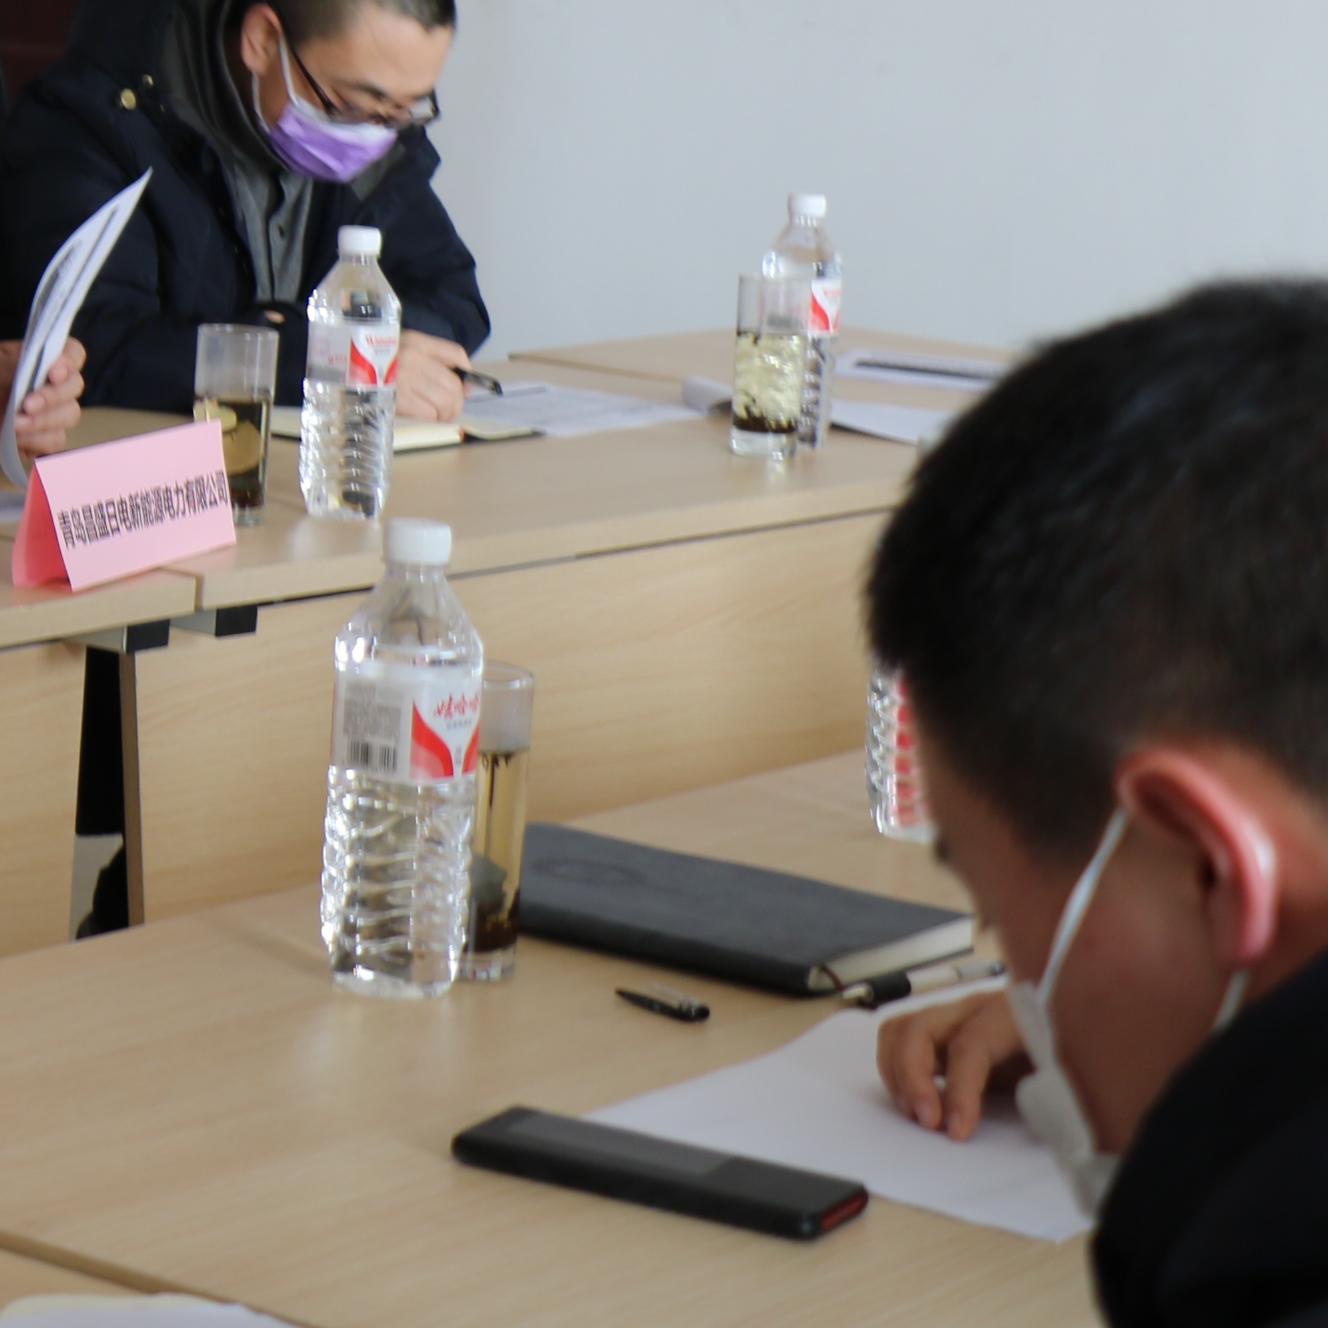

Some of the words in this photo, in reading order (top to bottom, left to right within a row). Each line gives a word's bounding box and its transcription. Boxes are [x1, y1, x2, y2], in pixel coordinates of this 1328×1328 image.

[57, 469, 230, 550] 青岛昌盛日电新能源电力有限公司
